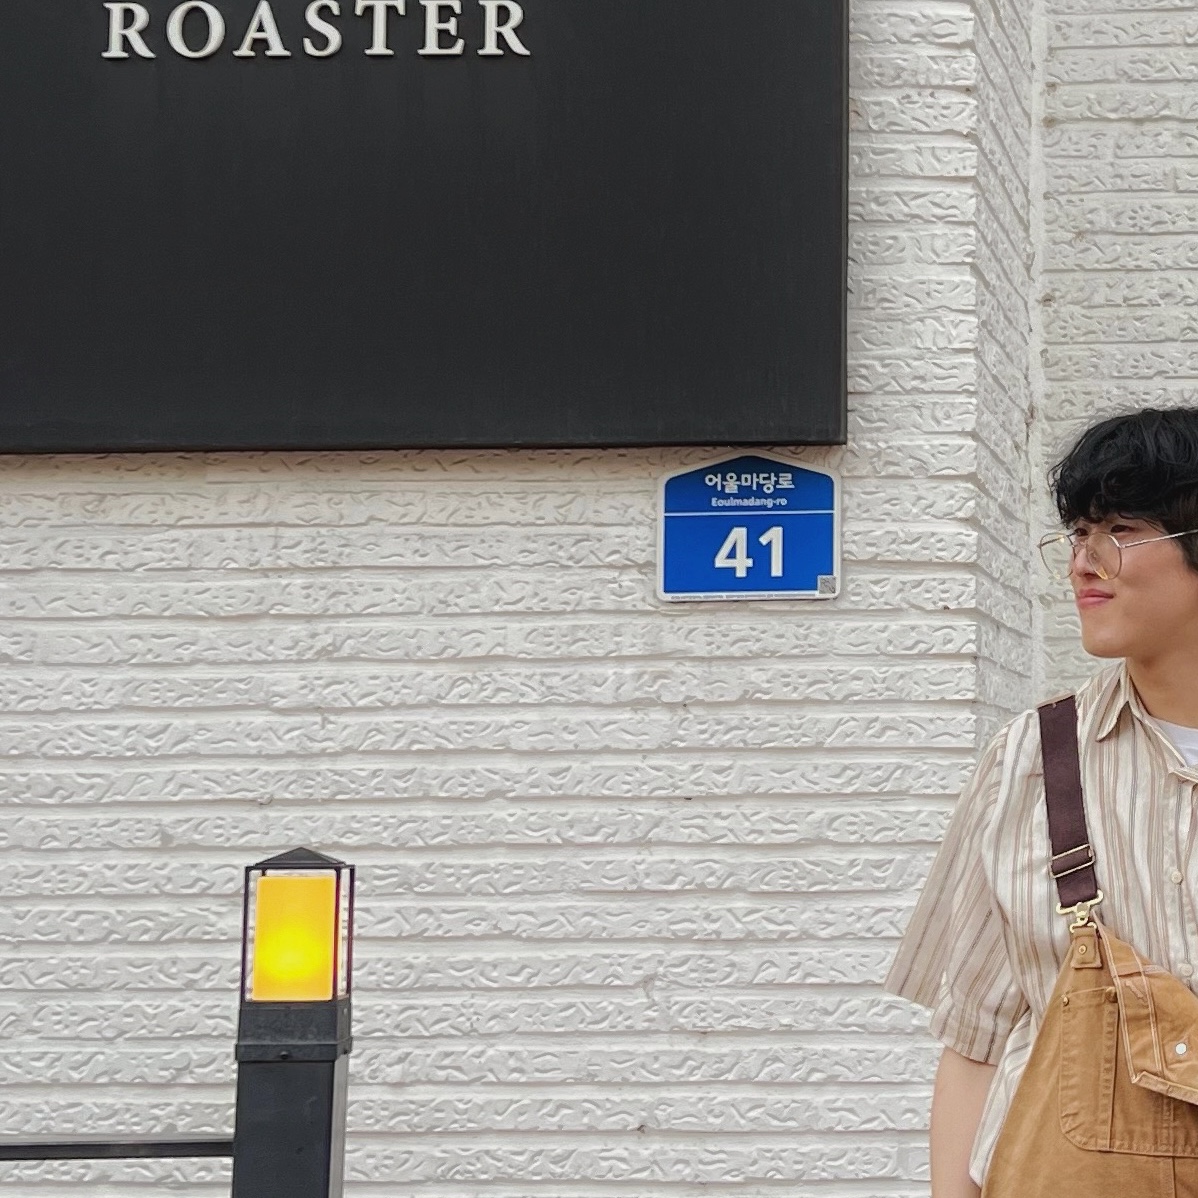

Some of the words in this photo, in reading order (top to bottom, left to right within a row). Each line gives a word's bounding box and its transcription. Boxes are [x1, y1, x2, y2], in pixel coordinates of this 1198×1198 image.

[101, 0, 532, 59] ROASTER
[705, 472, 795, 494] 어울마당로
[711, 496, 788, 508] Eoulmadang-ro
[714, 526, 784, 578] 41
